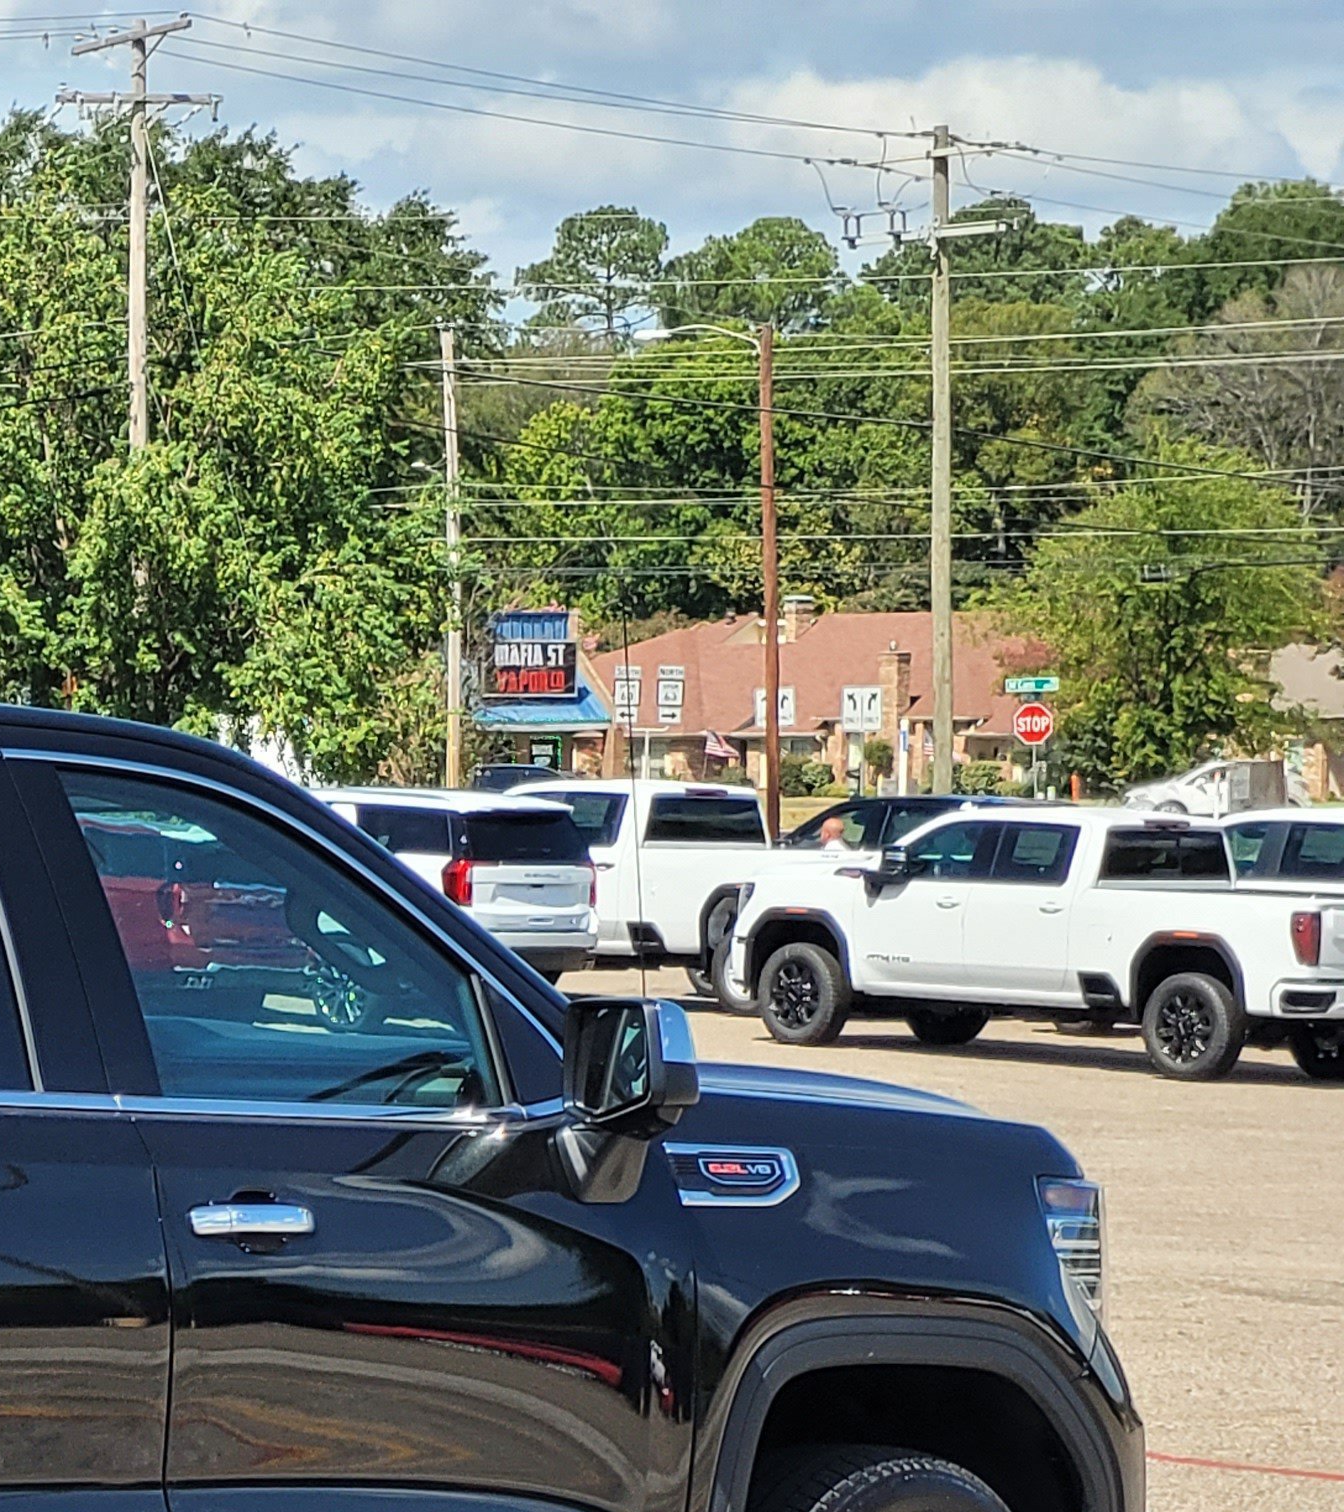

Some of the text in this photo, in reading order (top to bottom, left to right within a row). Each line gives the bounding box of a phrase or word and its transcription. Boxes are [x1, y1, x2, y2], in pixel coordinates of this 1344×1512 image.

[494, 643, 566, 667] MAFIA ST
[617, 667, 640, 676] SOTH
[1017, 715, 1050, 732] STOP
